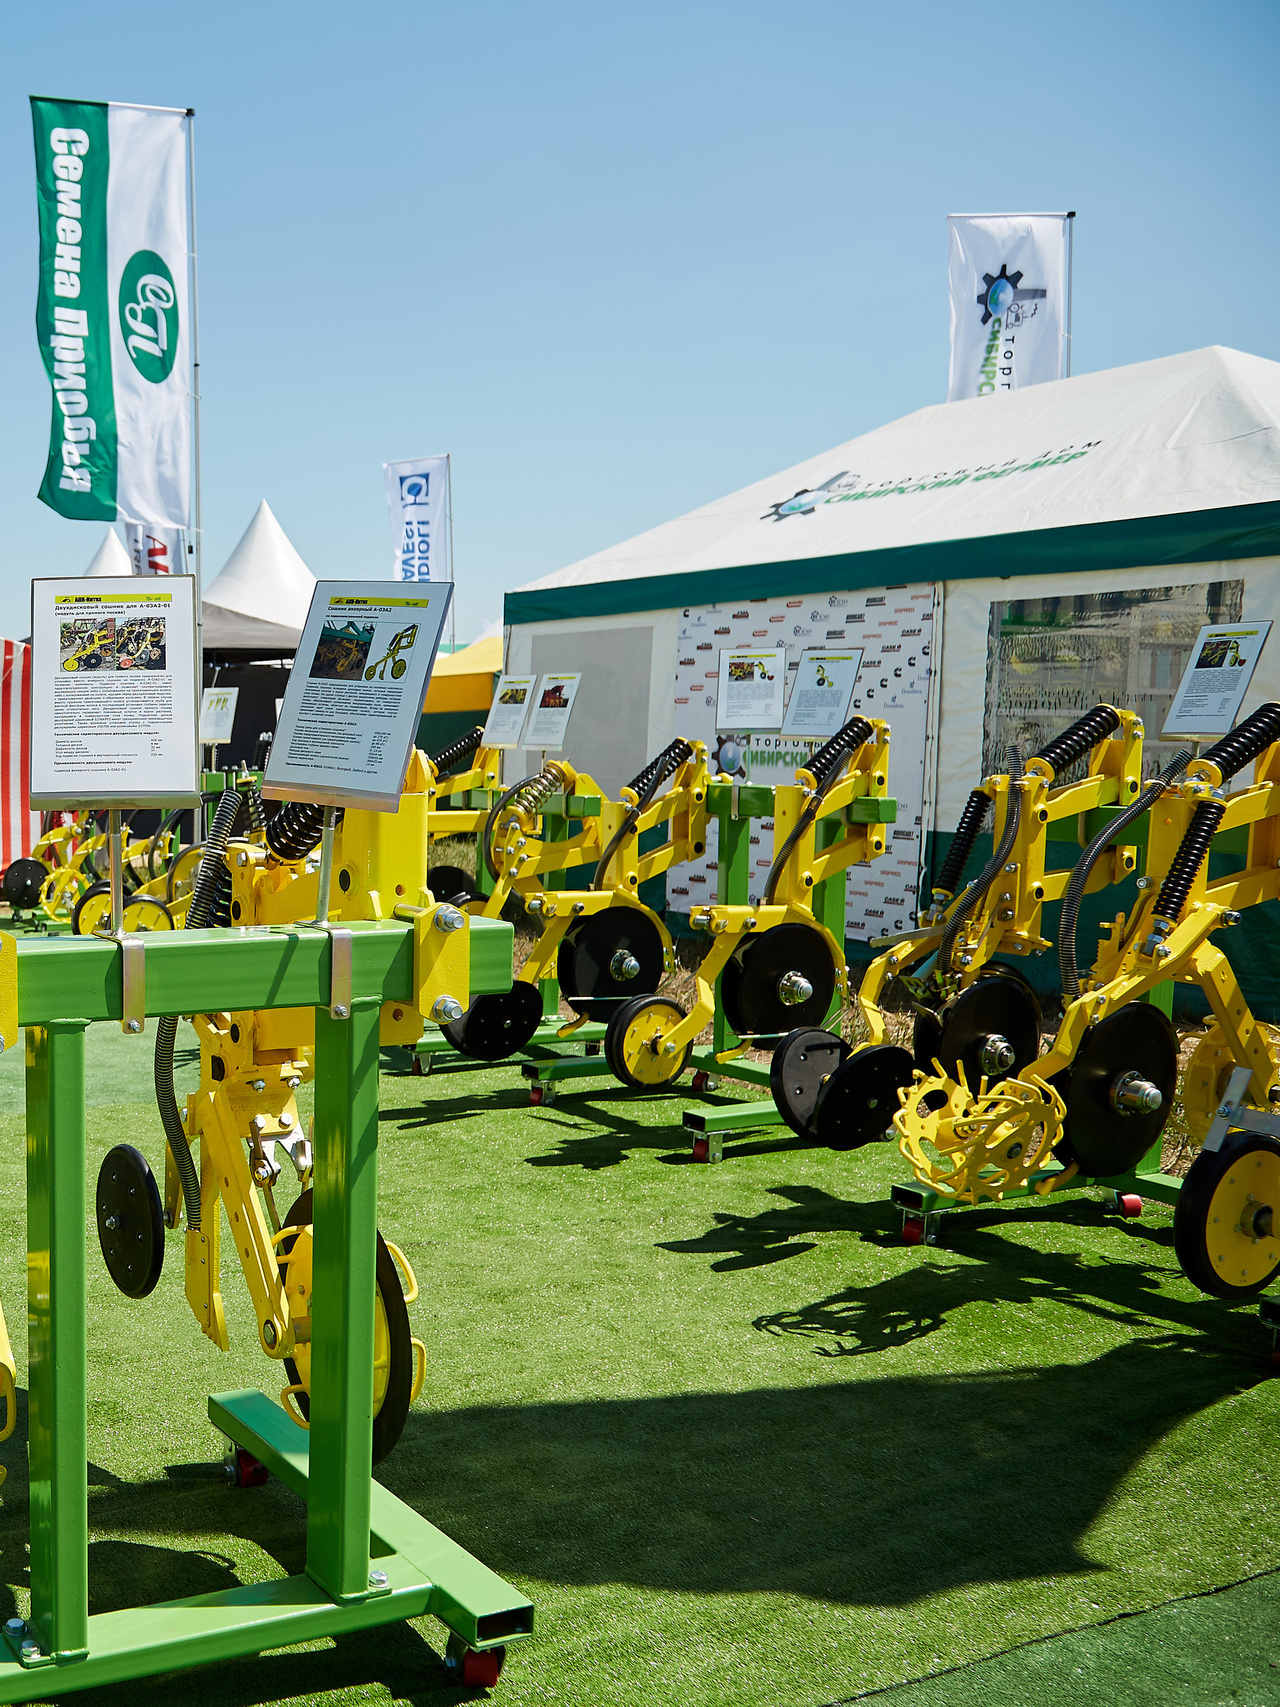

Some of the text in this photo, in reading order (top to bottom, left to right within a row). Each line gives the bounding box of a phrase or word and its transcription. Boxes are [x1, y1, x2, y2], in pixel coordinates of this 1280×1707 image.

[49, 126, 97, 493] Семена Приобья
[978, 318, 1002, 397] СИБИРС
[824, 451, 1088, 504] СИБИРСКИЙ ФЕРМЕР
[742, 750, 810, 766] СИБИРСКИ
